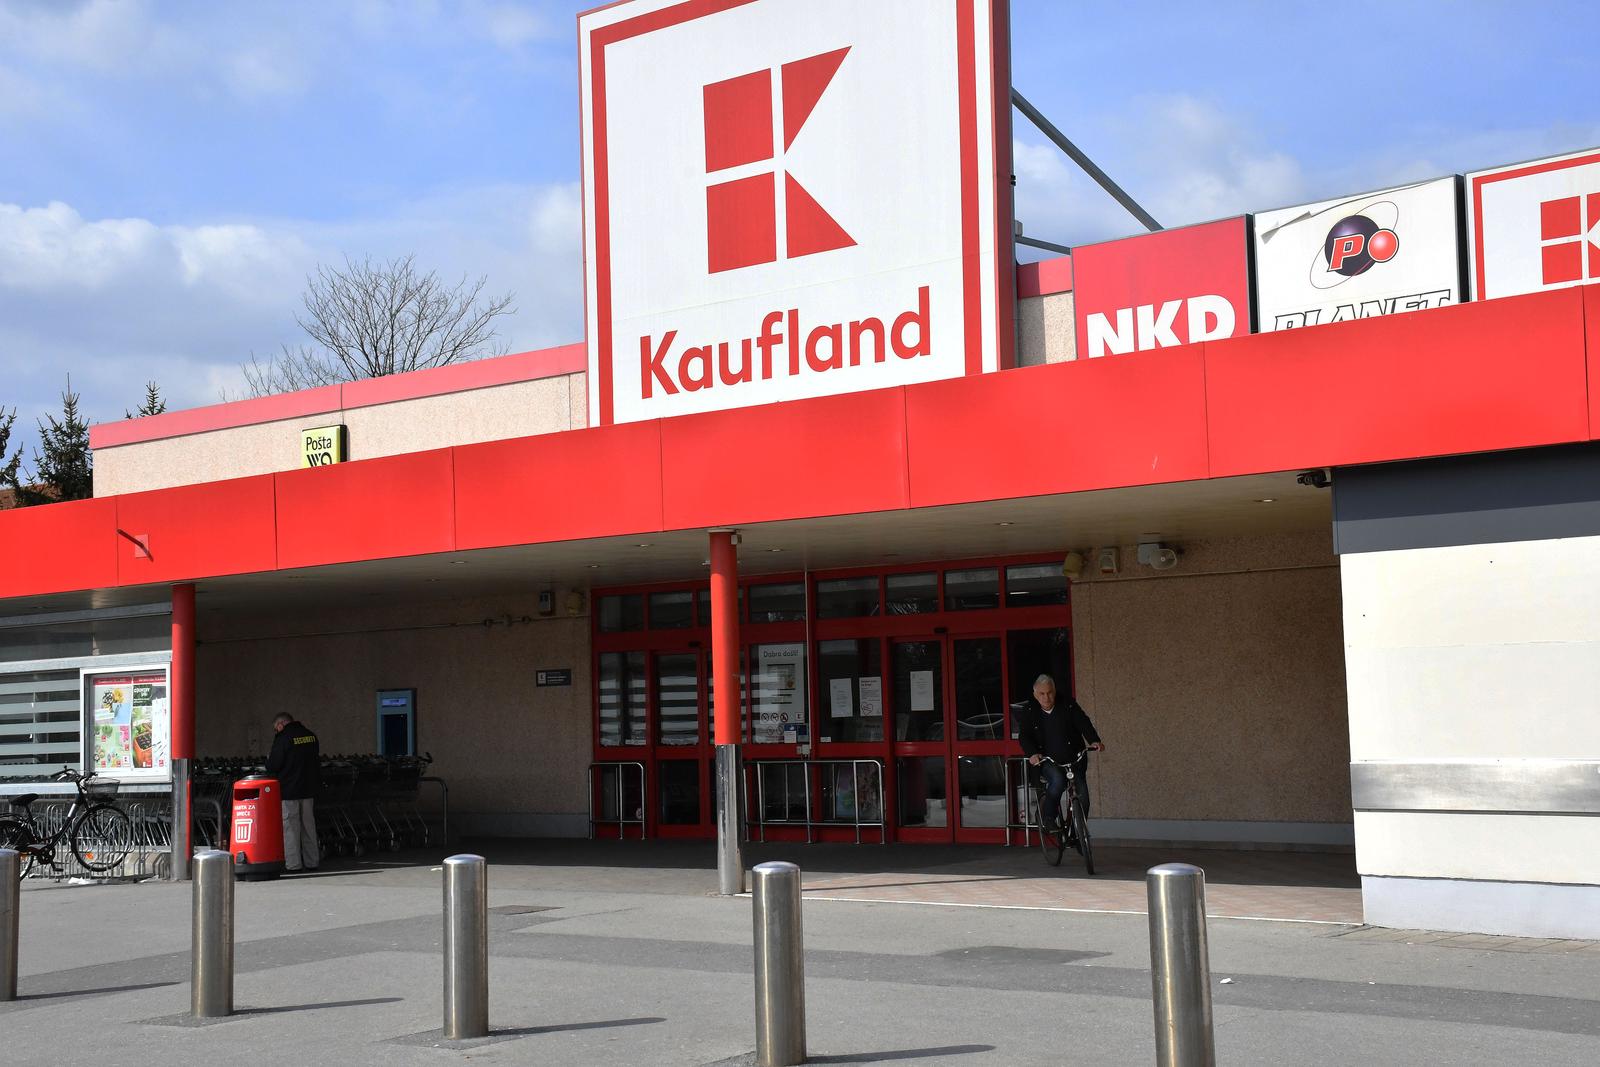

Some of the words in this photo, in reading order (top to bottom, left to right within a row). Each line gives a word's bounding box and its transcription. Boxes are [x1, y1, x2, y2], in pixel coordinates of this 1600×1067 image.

[1086, 294, 1236, 358] NKD
[640, 285, 931, 399] Kaufland
[306, 436, 332, 451] Pošta
[763, 650, 782, 658] Dobro
[293, 735, 316, 744] SECURITY
